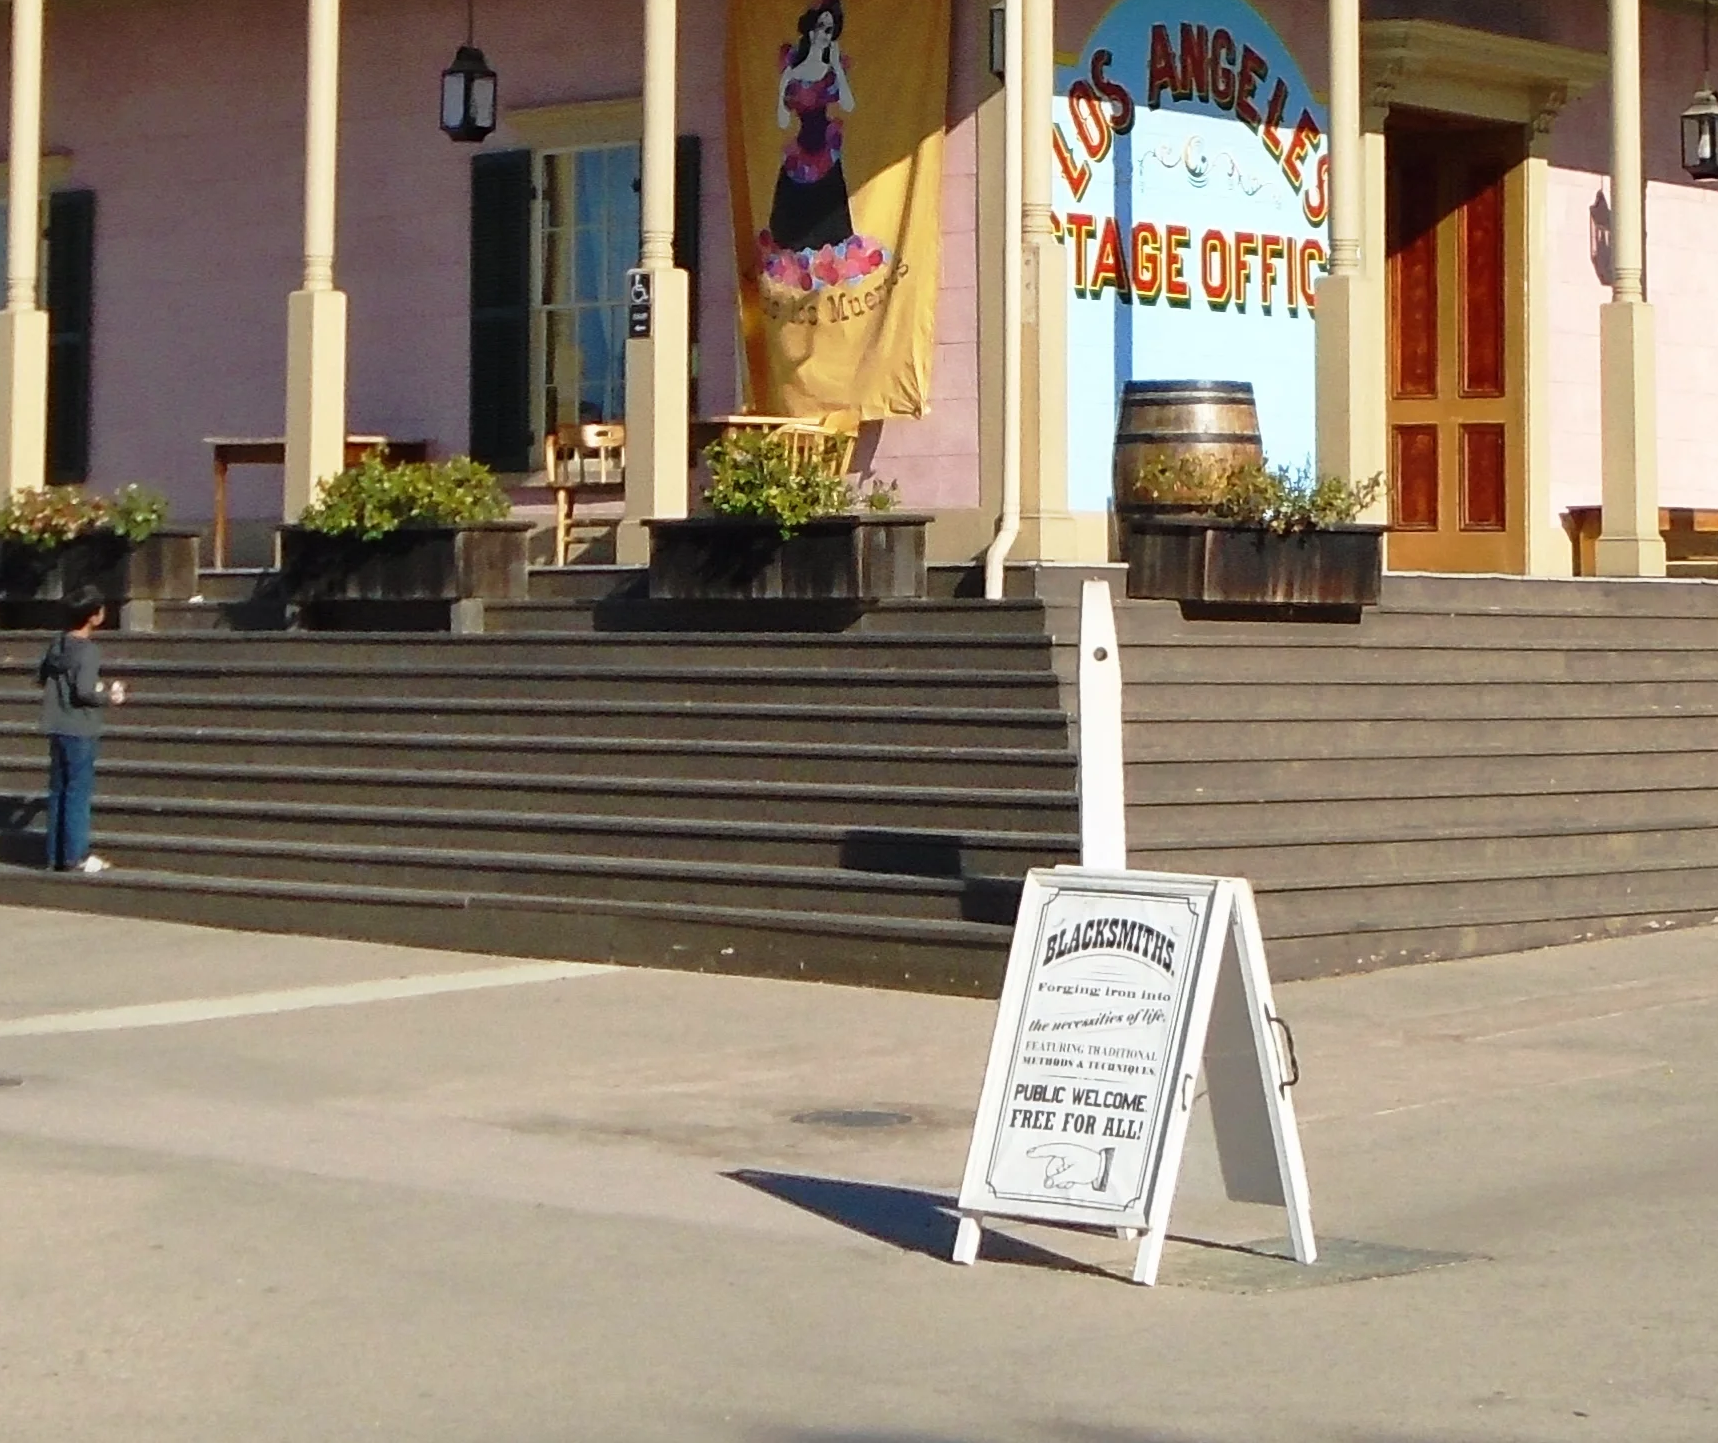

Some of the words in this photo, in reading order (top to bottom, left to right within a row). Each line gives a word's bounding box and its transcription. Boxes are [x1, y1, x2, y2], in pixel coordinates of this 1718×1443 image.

[1052, 48, 1136, 203] LOS
[1147, 20, 1329, 227] ANGELES
[1200, 226, 1330, 320] OFFIC
[826, 263, 910, 324] Muers
[1038, 982, 1101, 997] Forging
[1105, 986, 1136, 999] iron
[1141, 989, 1171, 1002] into
[1029, 1018, 1049, 1032] the
[1051, 1011, 1123, 1032] necessities
[1126, 1009, 1143, 1026] of
[1023, 1056, 1074, 1067] METHODS
[1025, 1040, 1084, 1054] FEATURING
[1088, 1044, 1158, 1062] TRADITIONAL
[1014, 1083, 1066, 1104] PUBLIC
[1009, 1108, 1056, 1131] FREE
[1061, 1112, 1097, 1135] FOR
[1102, 1116, 1144, 1140] ALL!
